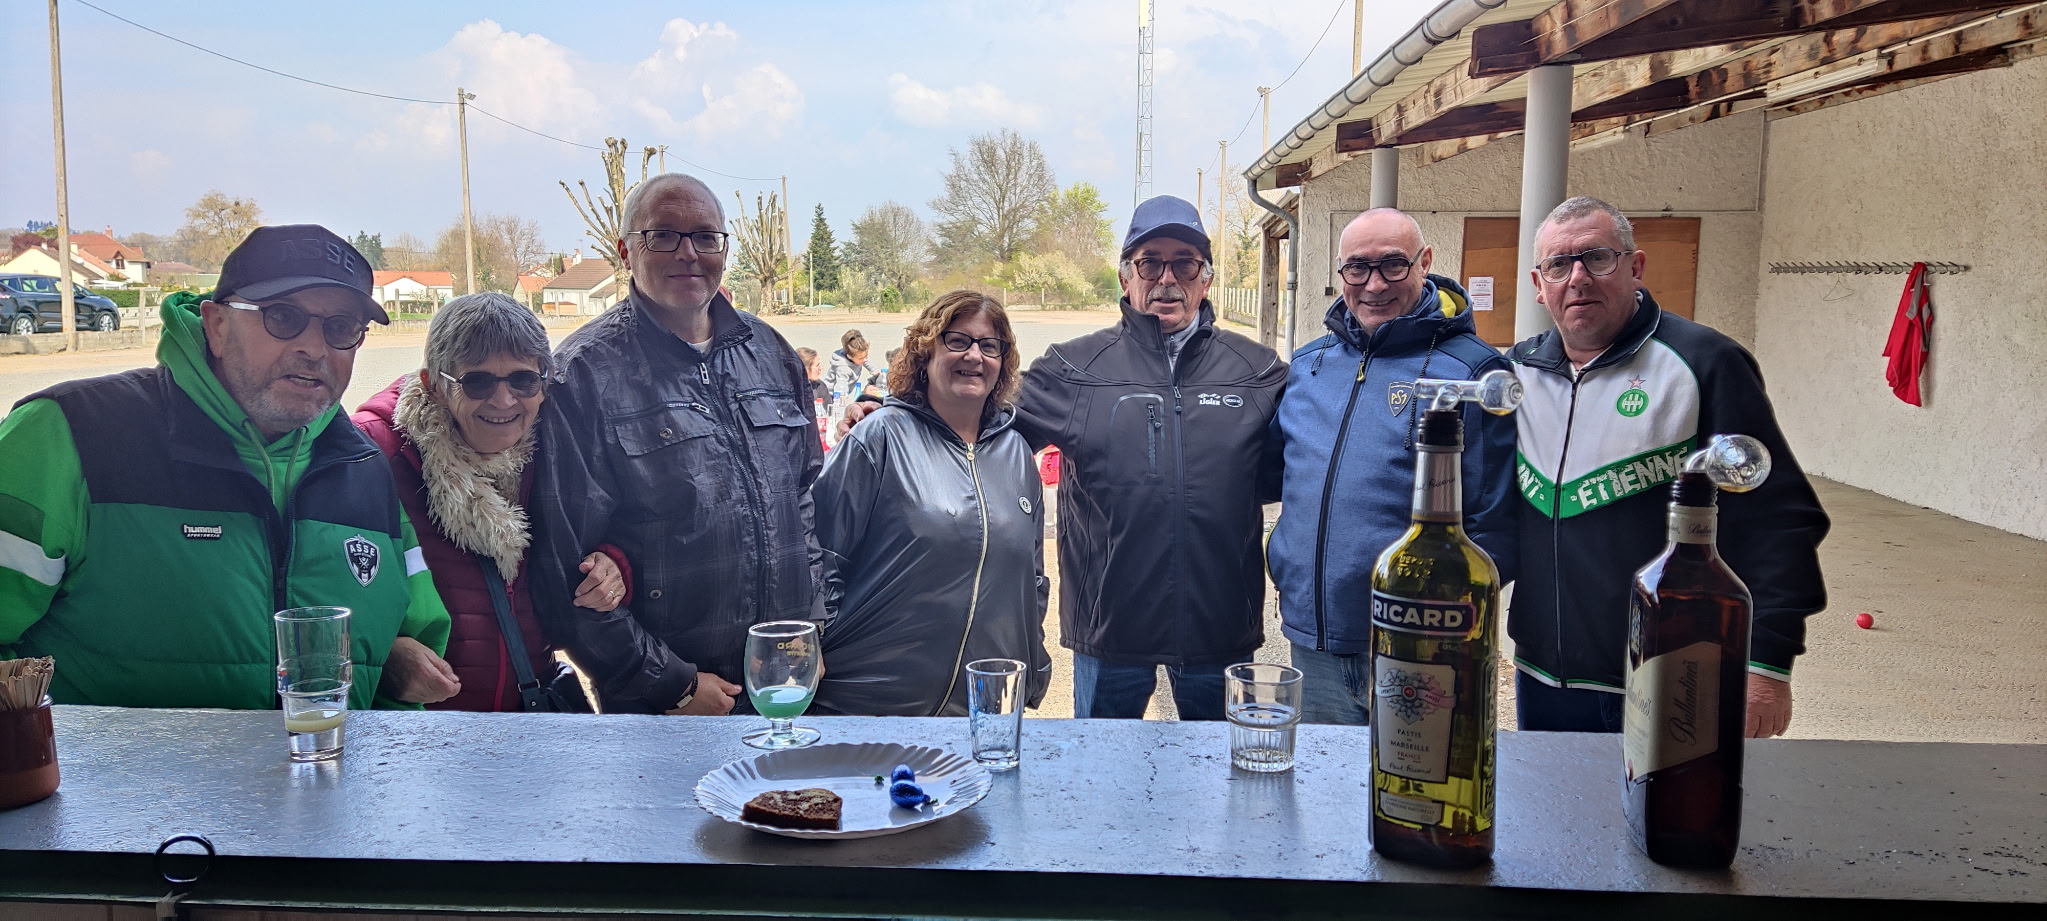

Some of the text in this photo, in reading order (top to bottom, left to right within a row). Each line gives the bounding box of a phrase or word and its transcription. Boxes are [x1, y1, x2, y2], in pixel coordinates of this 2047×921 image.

[1577, 446, 1688, 510] ETIENNE
[183, 524, 222, 534] hummel
[349, 543, 377, 557] ASSE
[1373, 599, 1464, 628] RICARD
[1397, 728, 1422, 739] PASTIS
[1390, 740, 1430, 752] MARSEILLE
[1397, 751, 1422, 760] FRANCE
